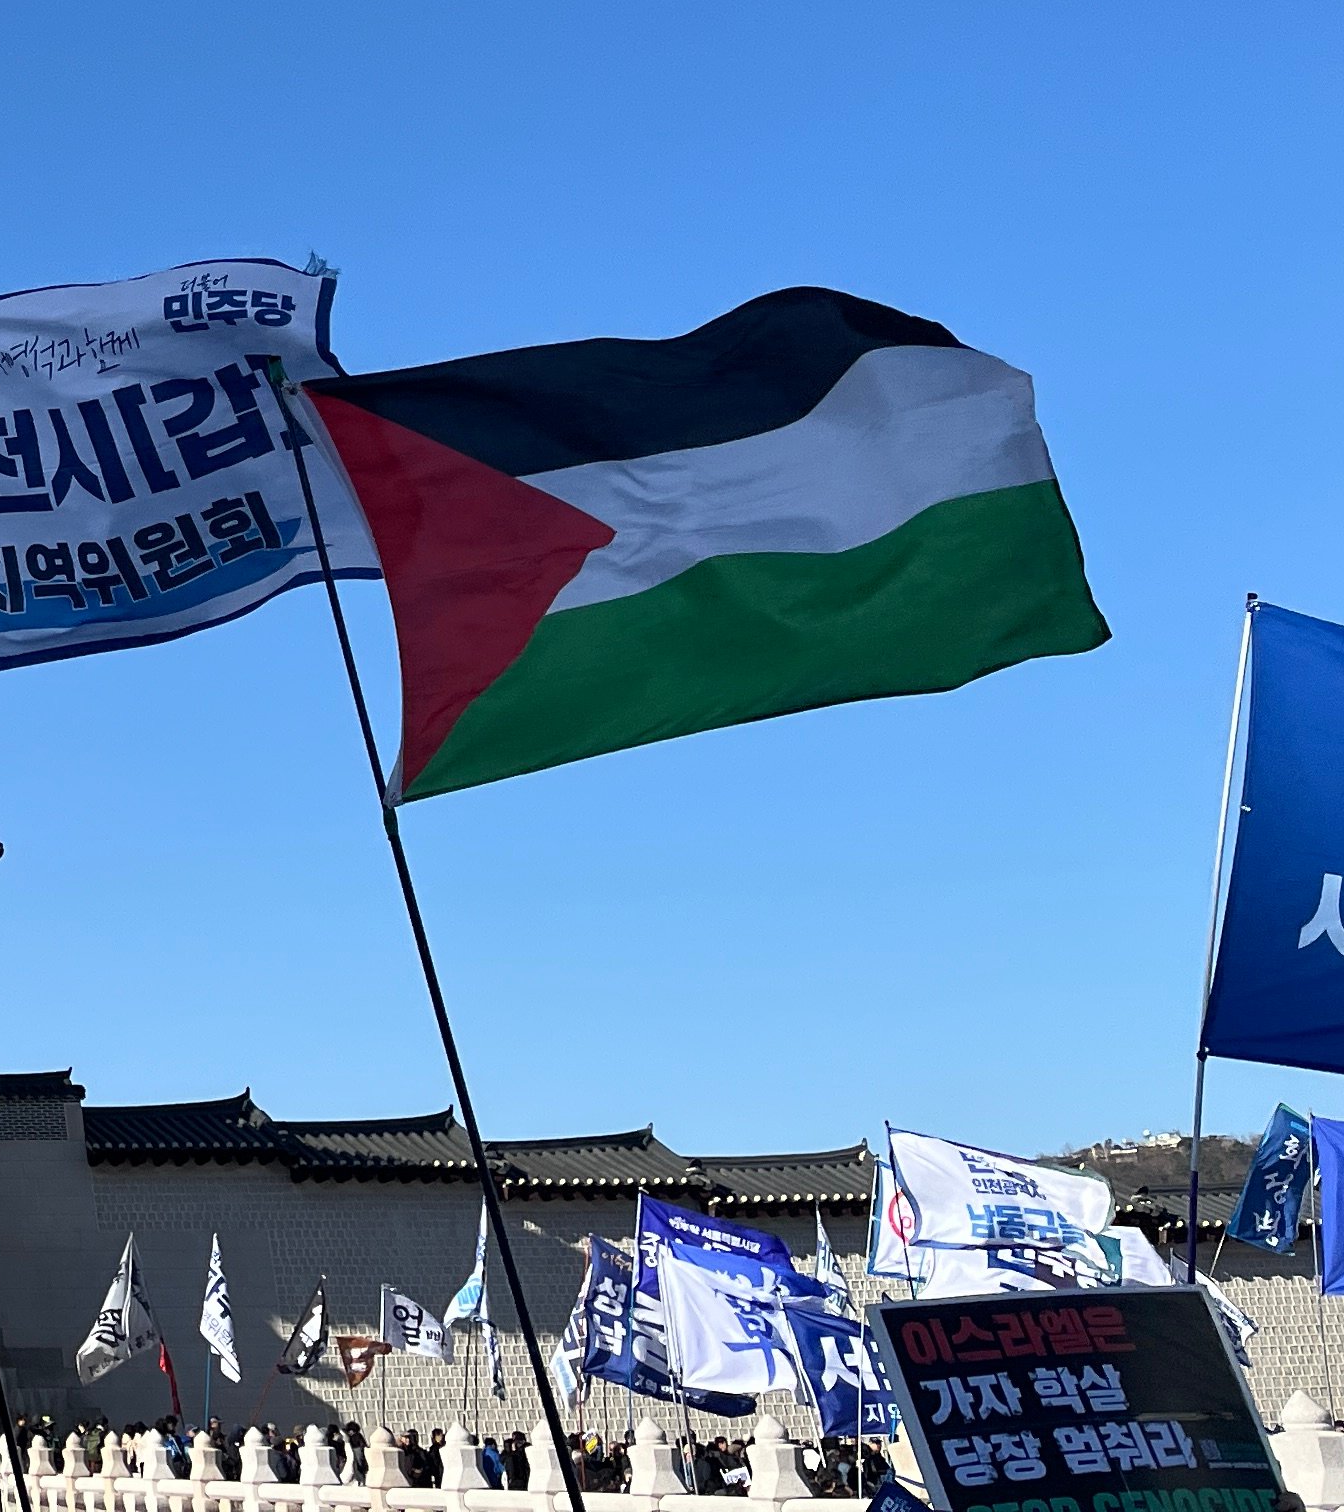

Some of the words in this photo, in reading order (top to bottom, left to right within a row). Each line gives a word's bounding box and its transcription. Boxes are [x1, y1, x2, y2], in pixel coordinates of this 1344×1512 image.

[163, 289, 296, 333] 민주당
[181, 273, 229, 292] 더불어
[820, 1335, 892, 1392] 서
[900, 1305, 1136, 1365] 이스라엘은
[919, 1373, 1022, 1426] 가자
[1028, 1363, 1131, 1415] 학살
[941, 1432, 1047, 1487] 당장
[1053, 1420, 1200, 1475] 멈춰라
